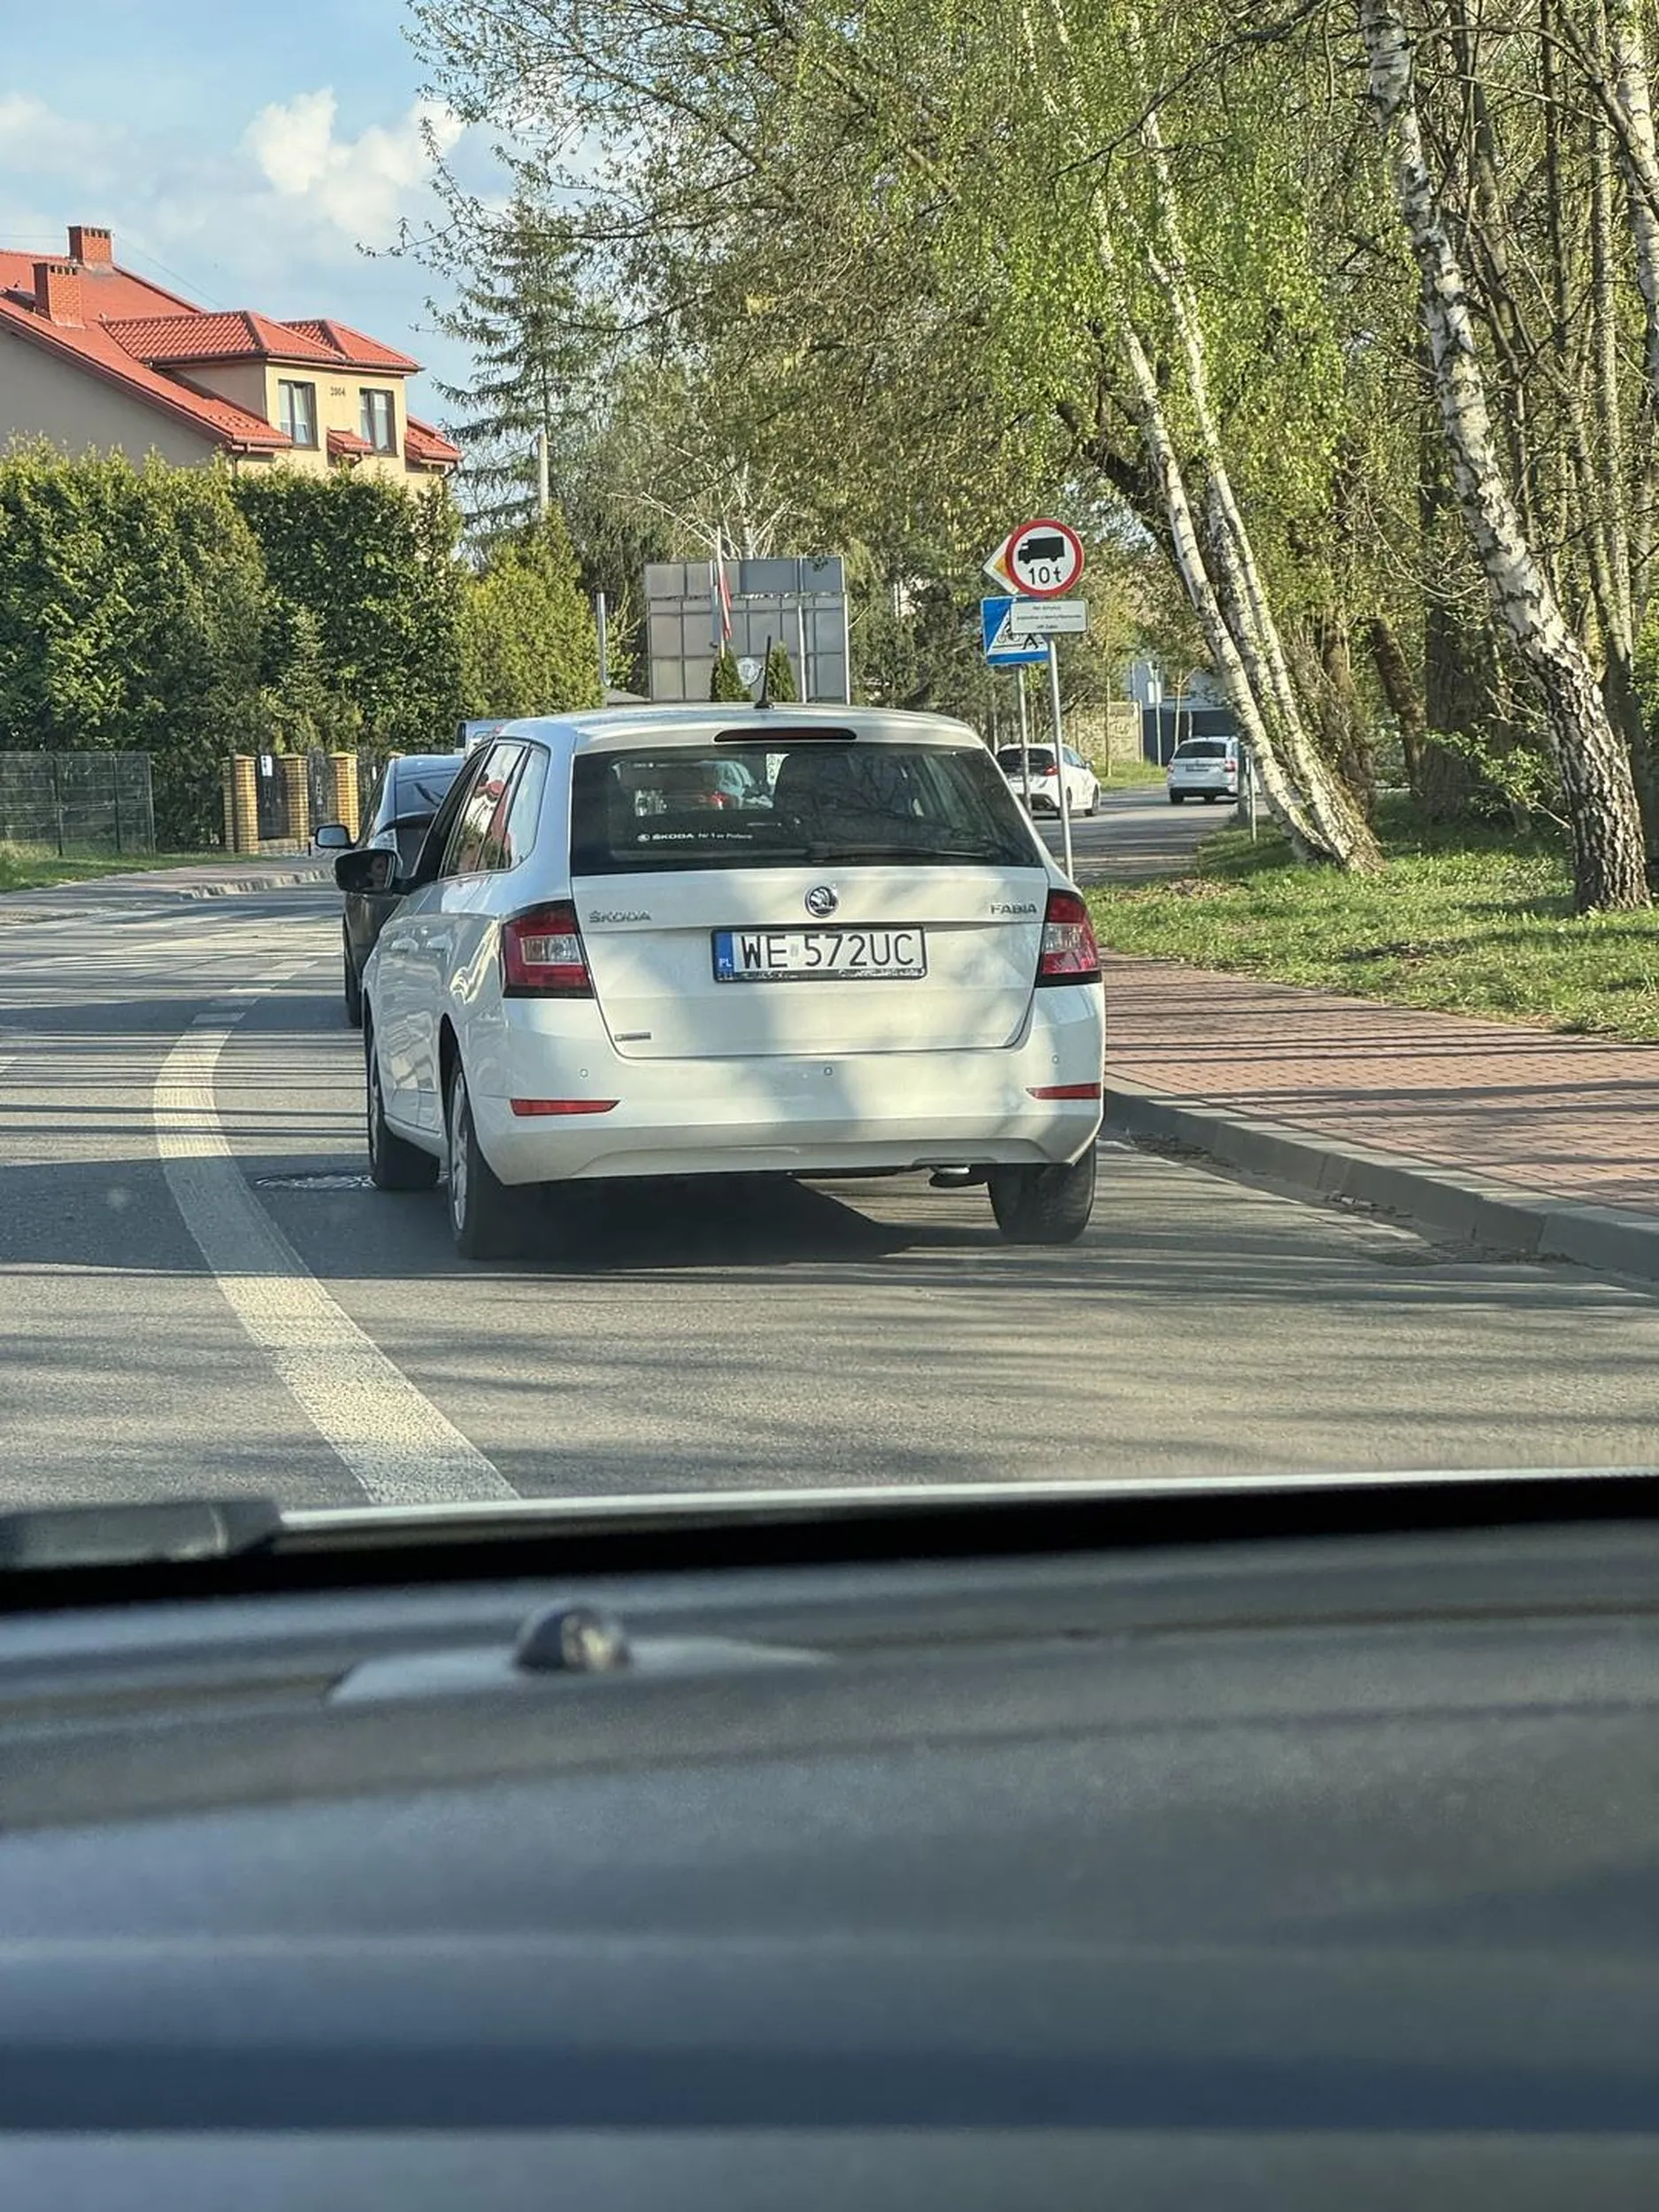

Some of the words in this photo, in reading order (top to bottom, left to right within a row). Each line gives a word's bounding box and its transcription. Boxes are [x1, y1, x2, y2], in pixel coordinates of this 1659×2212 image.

[990, 902, 1038, 915] FABIA
[588, 910, 653, 924] ŠKODA
[741, 934, 788, 969] WE
[803, 933, 914, 967] 572UC
[718, 957, 733, 967] PL
